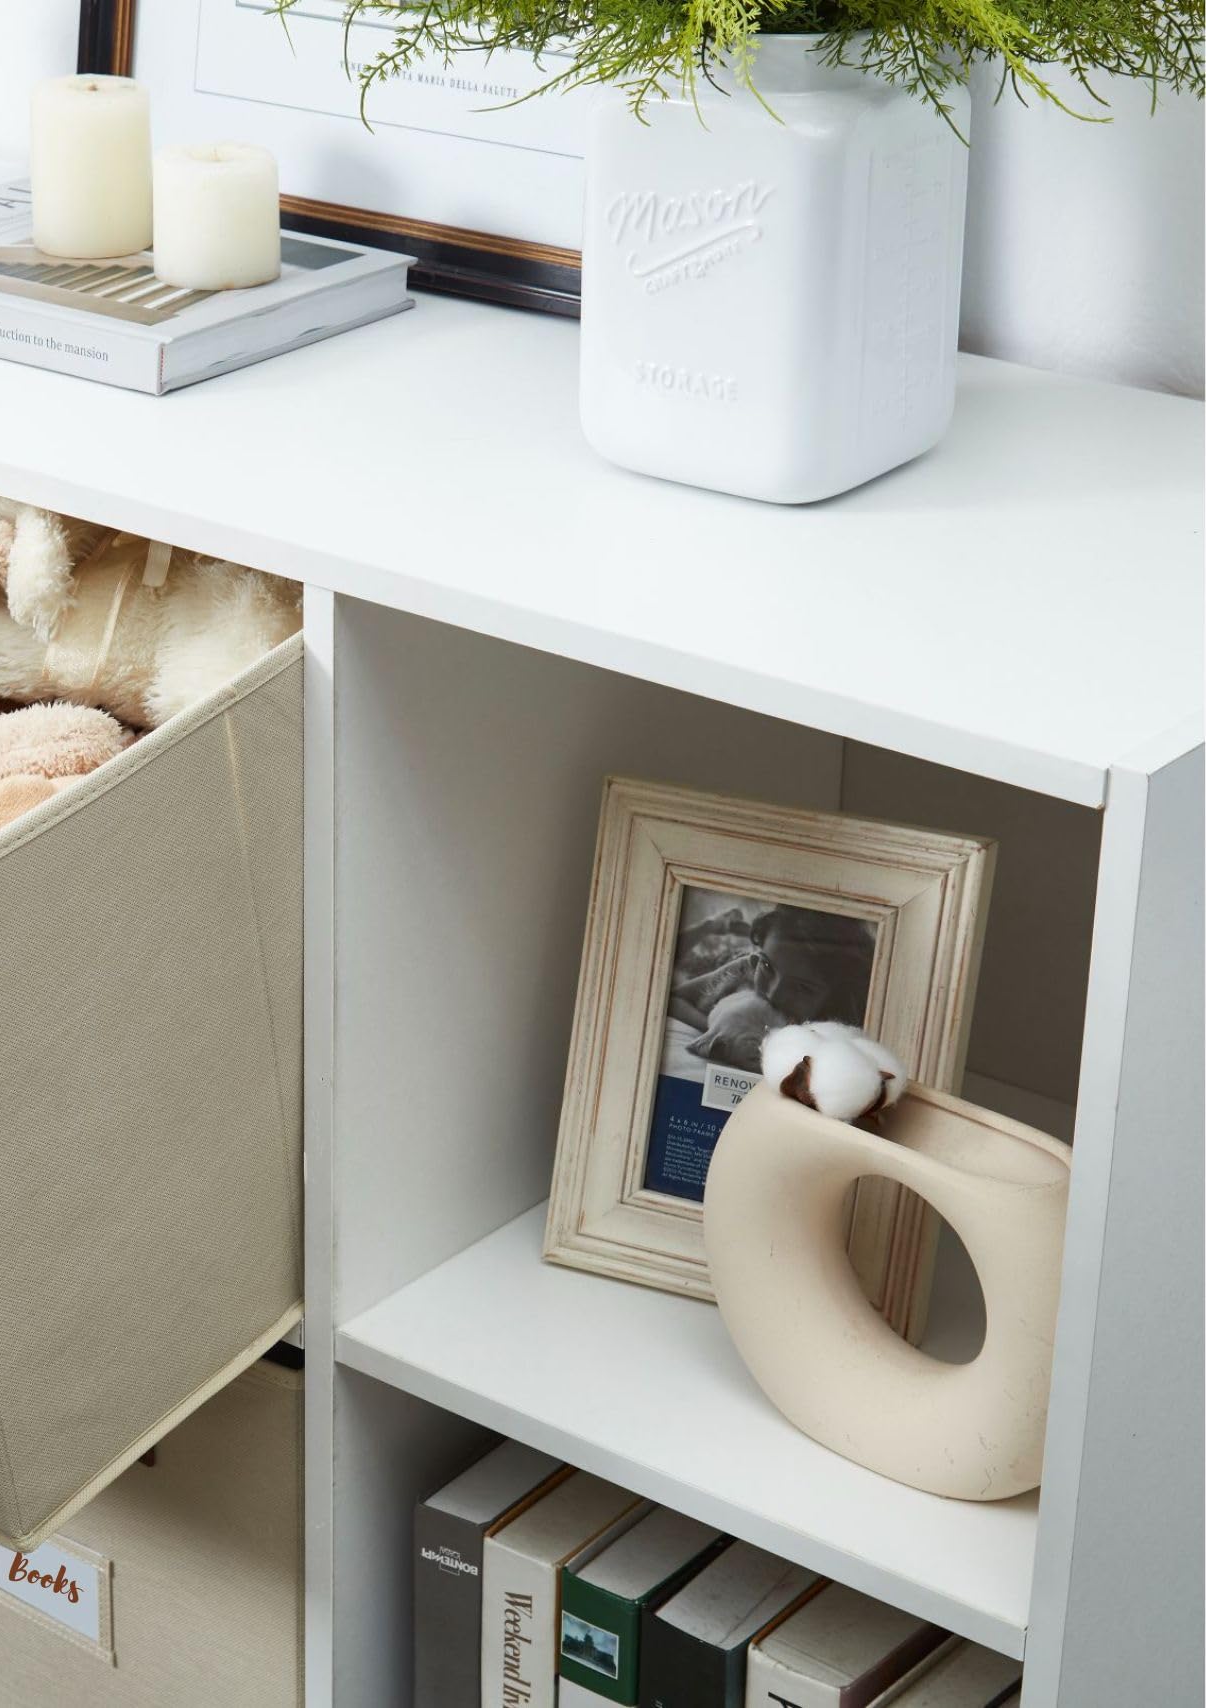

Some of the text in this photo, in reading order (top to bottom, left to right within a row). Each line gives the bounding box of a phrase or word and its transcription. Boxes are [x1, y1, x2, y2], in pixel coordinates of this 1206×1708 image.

[418, 72, 445, 87] MARIA
[450, 78, 478, 92] DELLA
[483, 83, 518, 98] SALUTE
[607, 180, 777, 246] Mason
[33, 335, 44, 347] to
[45, 336, 63, 351] the
[64, 342, 109, 362] mansion
[634, 360, 739, 402] STORAGE
[8, 1552, 84, 1603] Books
[503, 1591, 532, 1687] Weekend
